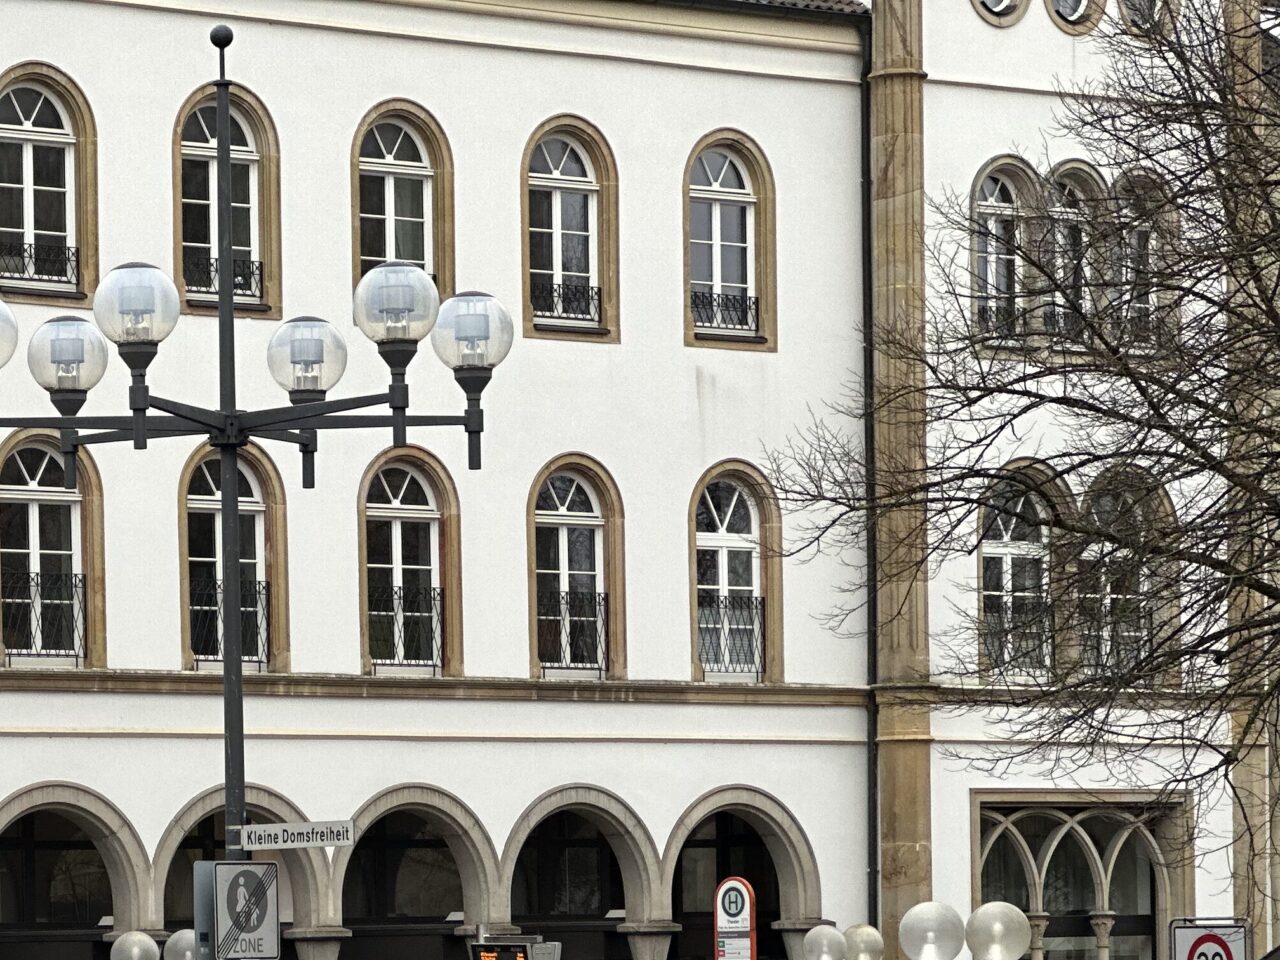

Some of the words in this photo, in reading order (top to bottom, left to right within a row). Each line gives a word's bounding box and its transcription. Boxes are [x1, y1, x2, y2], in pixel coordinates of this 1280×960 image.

[247, 830, 279, 846] Kleine
[282, 826, 350, 844] Domsfreiheit
[233, 938, 264, 953] ZONE
